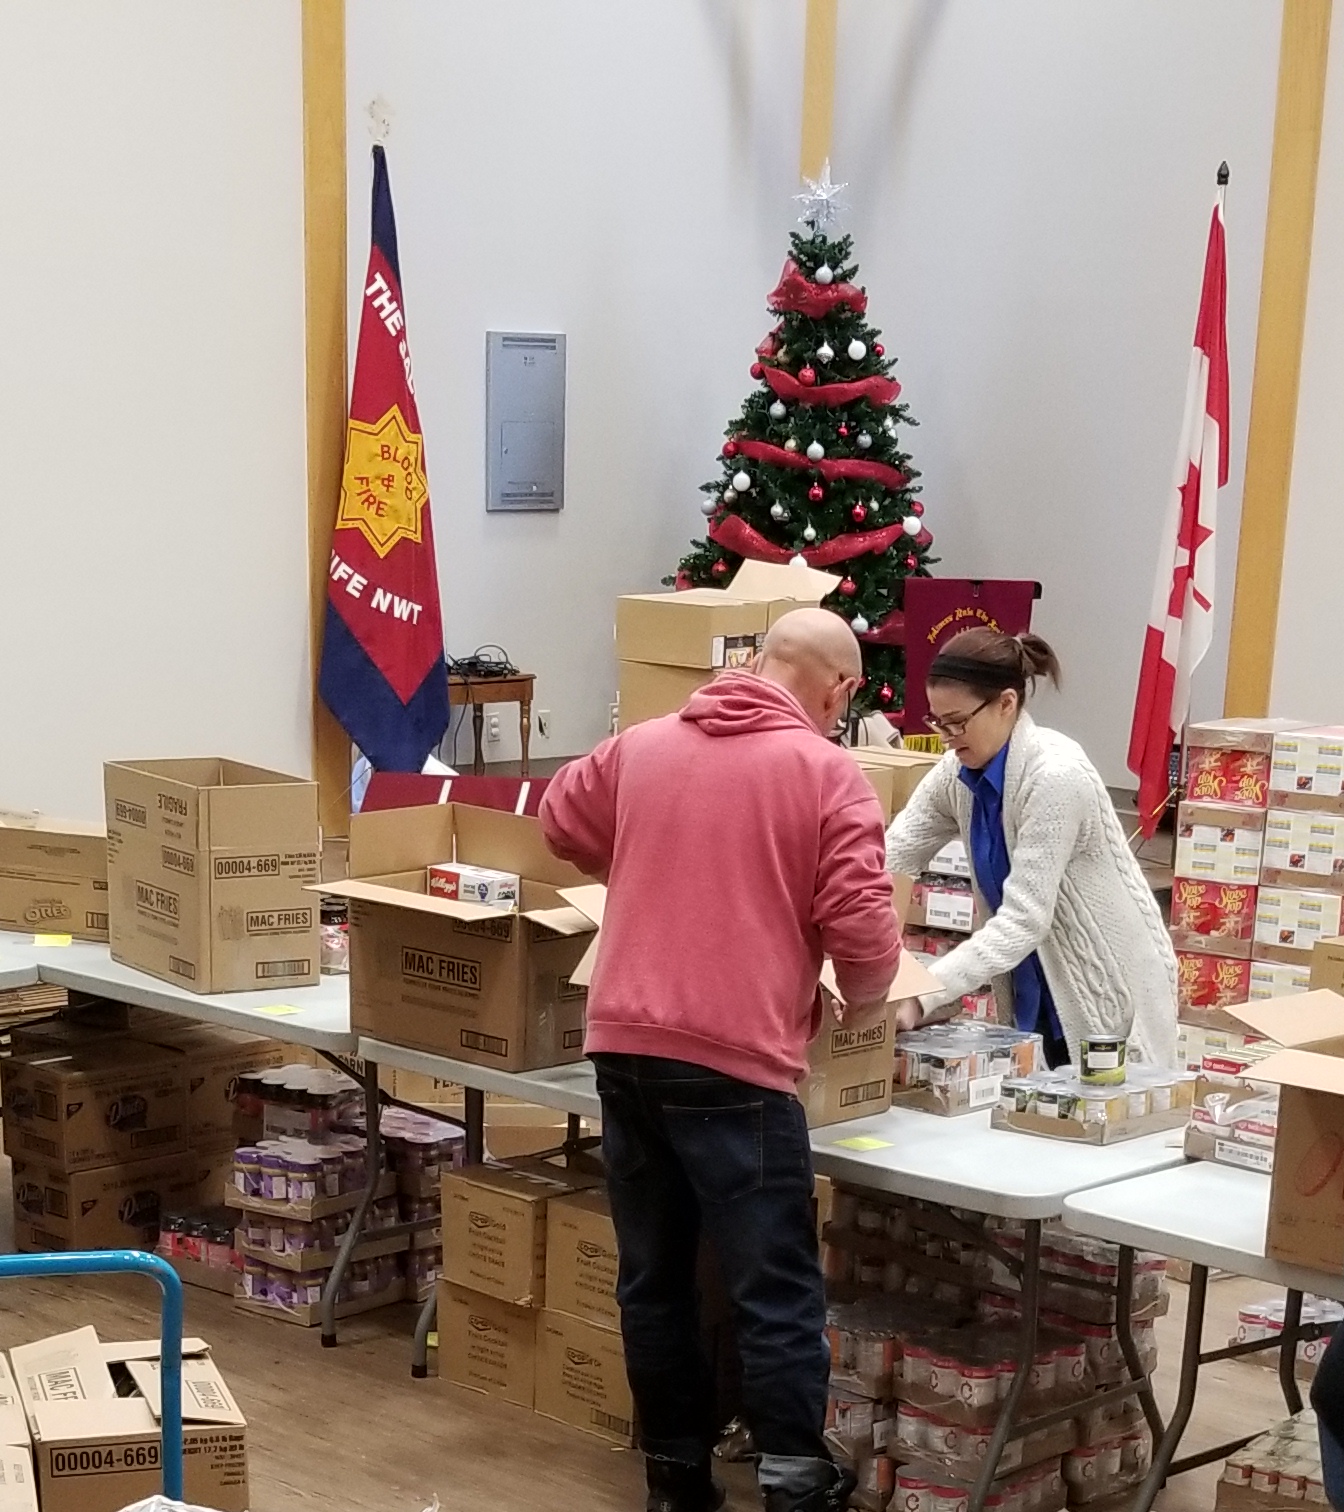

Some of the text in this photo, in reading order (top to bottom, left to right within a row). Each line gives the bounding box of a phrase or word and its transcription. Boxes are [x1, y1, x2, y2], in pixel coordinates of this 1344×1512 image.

[365, 272, 405, 337] THE
[381, 444, 414, 501] BLOOD
[353, 476, 389, 518] FIRE
[329, 549, 423, 625] IFE NWT
[157, 793, 188, 817] FRAGILE
[217, 858, 278, 876] 00004-669
[137, 884, 179, 916] MAC FRIES
[1176, 882, 1207, 904] Stove
[1185, 893, 1203, 908] Top
[1215, 885, 1248, 908] Stove
[24, 904, 72, 925] OREO
[1227, 897, 1244, 914] Top
[249, 911, 309, 928] MAC FRIES
[405, 950, 479, 986] MAC FRIES
[1212, 959, 1244, 983] Stove
[1223, 973, 1239, 988] Top
[834, 1030, 856, 1047] MAC
[55, 1446, 158, 1473] 00004-669
